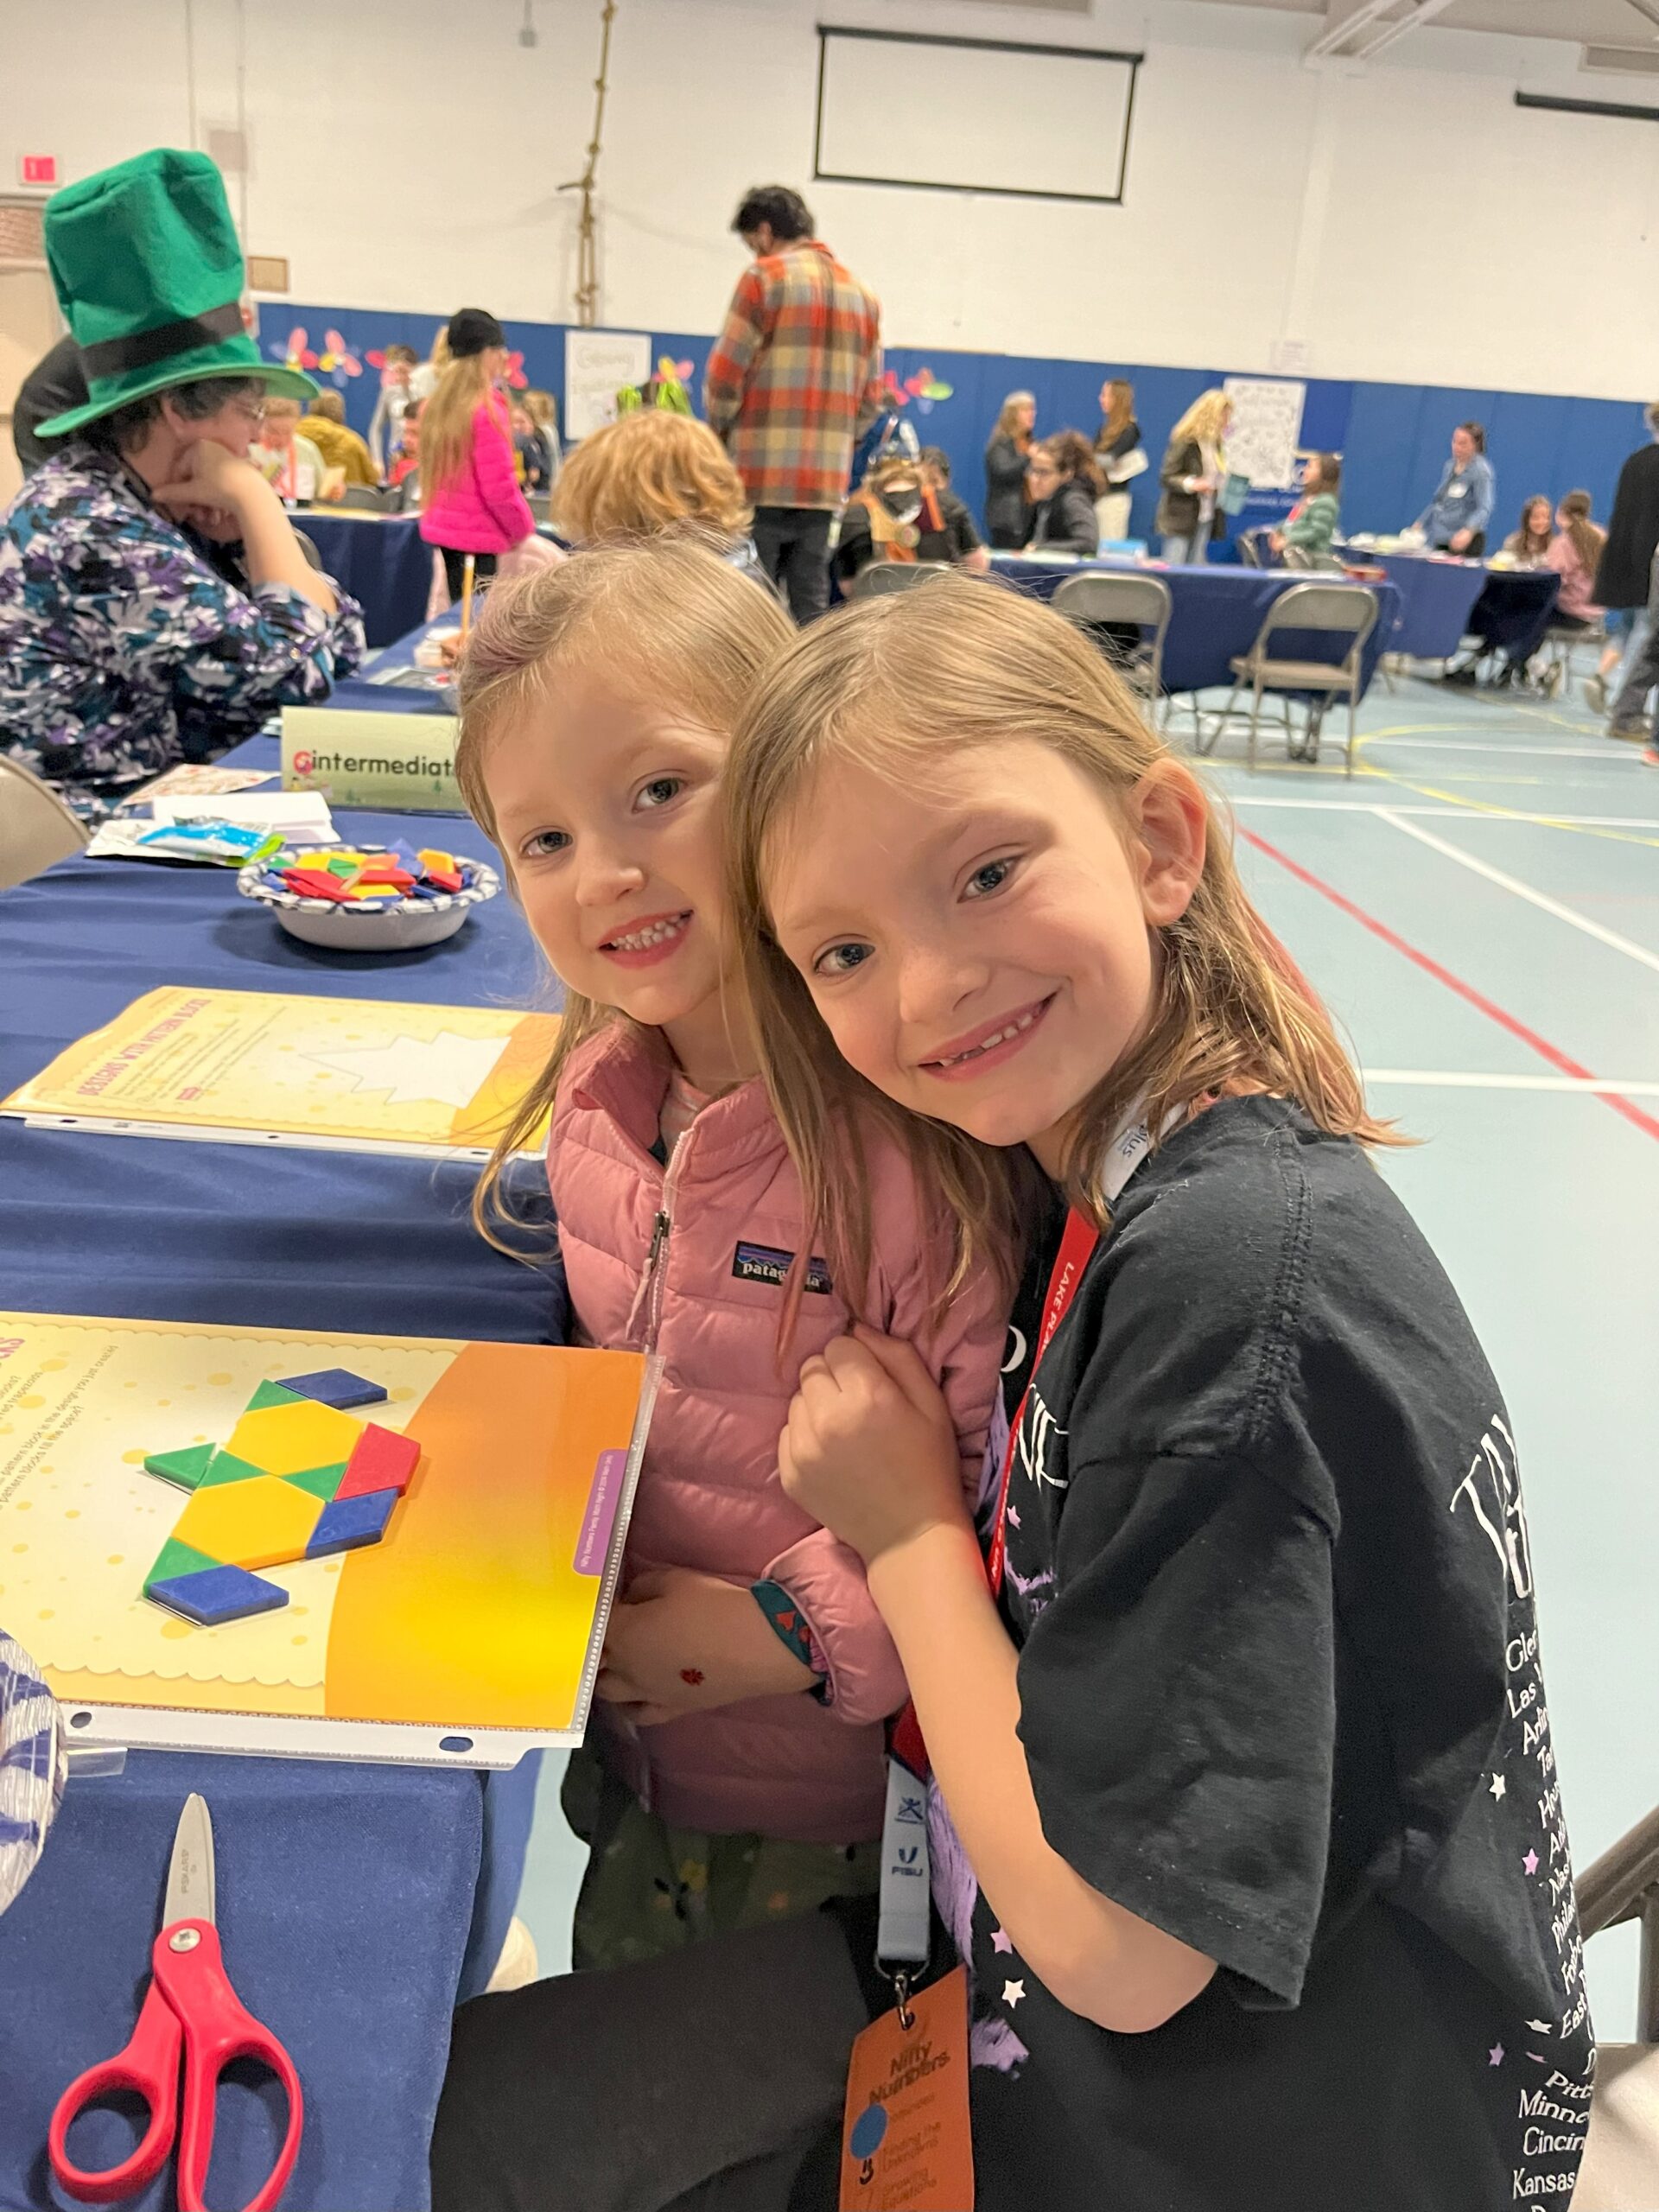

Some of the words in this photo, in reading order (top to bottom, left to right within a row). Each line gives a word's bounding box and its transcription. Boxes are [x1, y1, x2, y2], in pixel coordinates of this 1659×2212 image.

[313, 750, 455, 777] intermediat
[743, 1263, 820, 1287] patagia
[1053, 1262, 1074, 1310] LAKE
[1507, 1682, 1536, 1719] Las
[1513, 2167, 1575, 2200] Kansas
